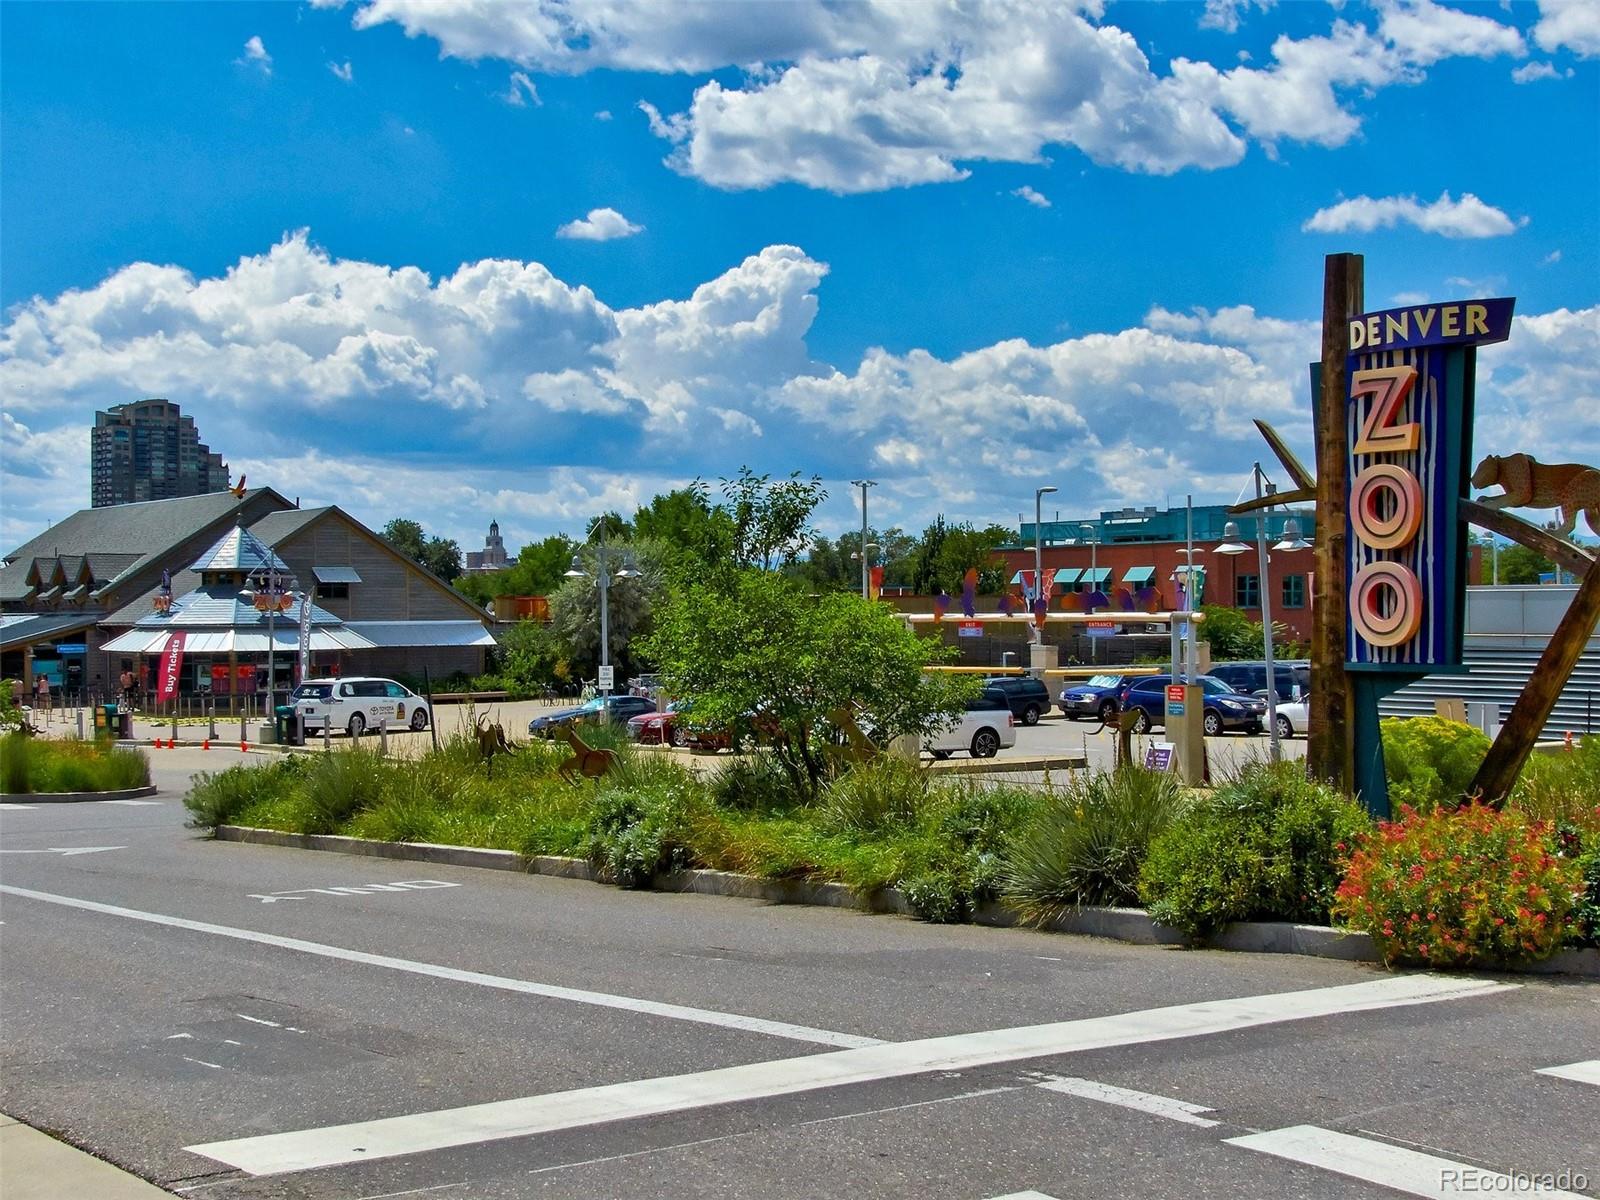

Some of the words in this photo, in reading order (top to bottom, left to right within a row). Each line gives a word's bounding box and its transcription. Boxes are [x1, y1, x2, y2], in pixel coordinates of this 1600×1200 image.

[1350, 304, 1490, 350] DENVER
[1350, 365, 1423, 647] ZOO
[167, 639, 181, 669] Tickets
[165, 670, 176, 693] Buy
